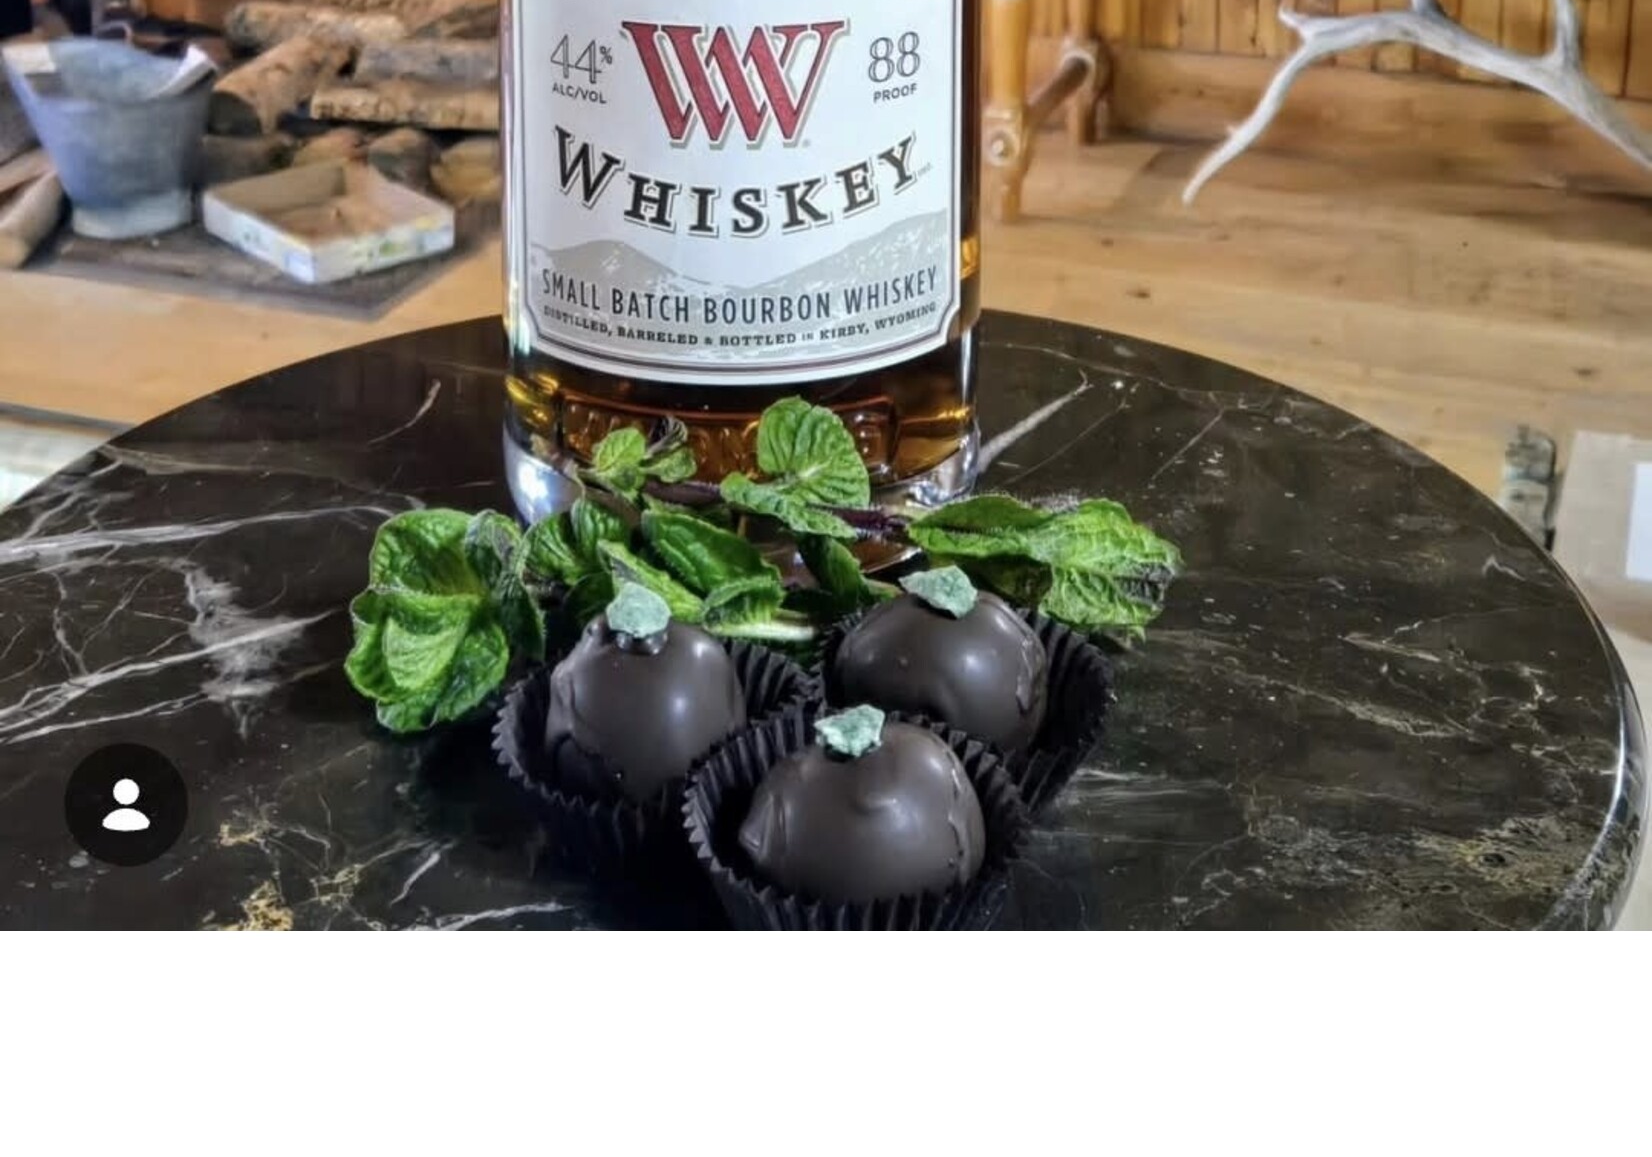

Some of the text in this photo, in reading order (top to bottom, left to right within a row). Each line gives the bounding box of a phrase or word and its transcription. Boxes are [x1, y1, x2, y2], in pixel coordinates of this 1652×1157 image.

[549, 33, 613, 84] 44%
[867, 30, 921, 83] 88
[552, 82, 607, 104] ALC/VOL
[873, 82, 918, 104] PROOF
[553, 124, 917, 239] WHISKEY
[542, 264, 937, 325] SMALL BATCH BOURBON WHISKEY
[543, 304, 613, 337] DISTILLED,
[616, 325, 699, 345] BARRELED
[703, 336, 714, 345] &
[719, 333, 797, 346] BOTTLED
[819, 322, 870, 341] KIRBY,
[874, 301, 937, 331] WYOMING
